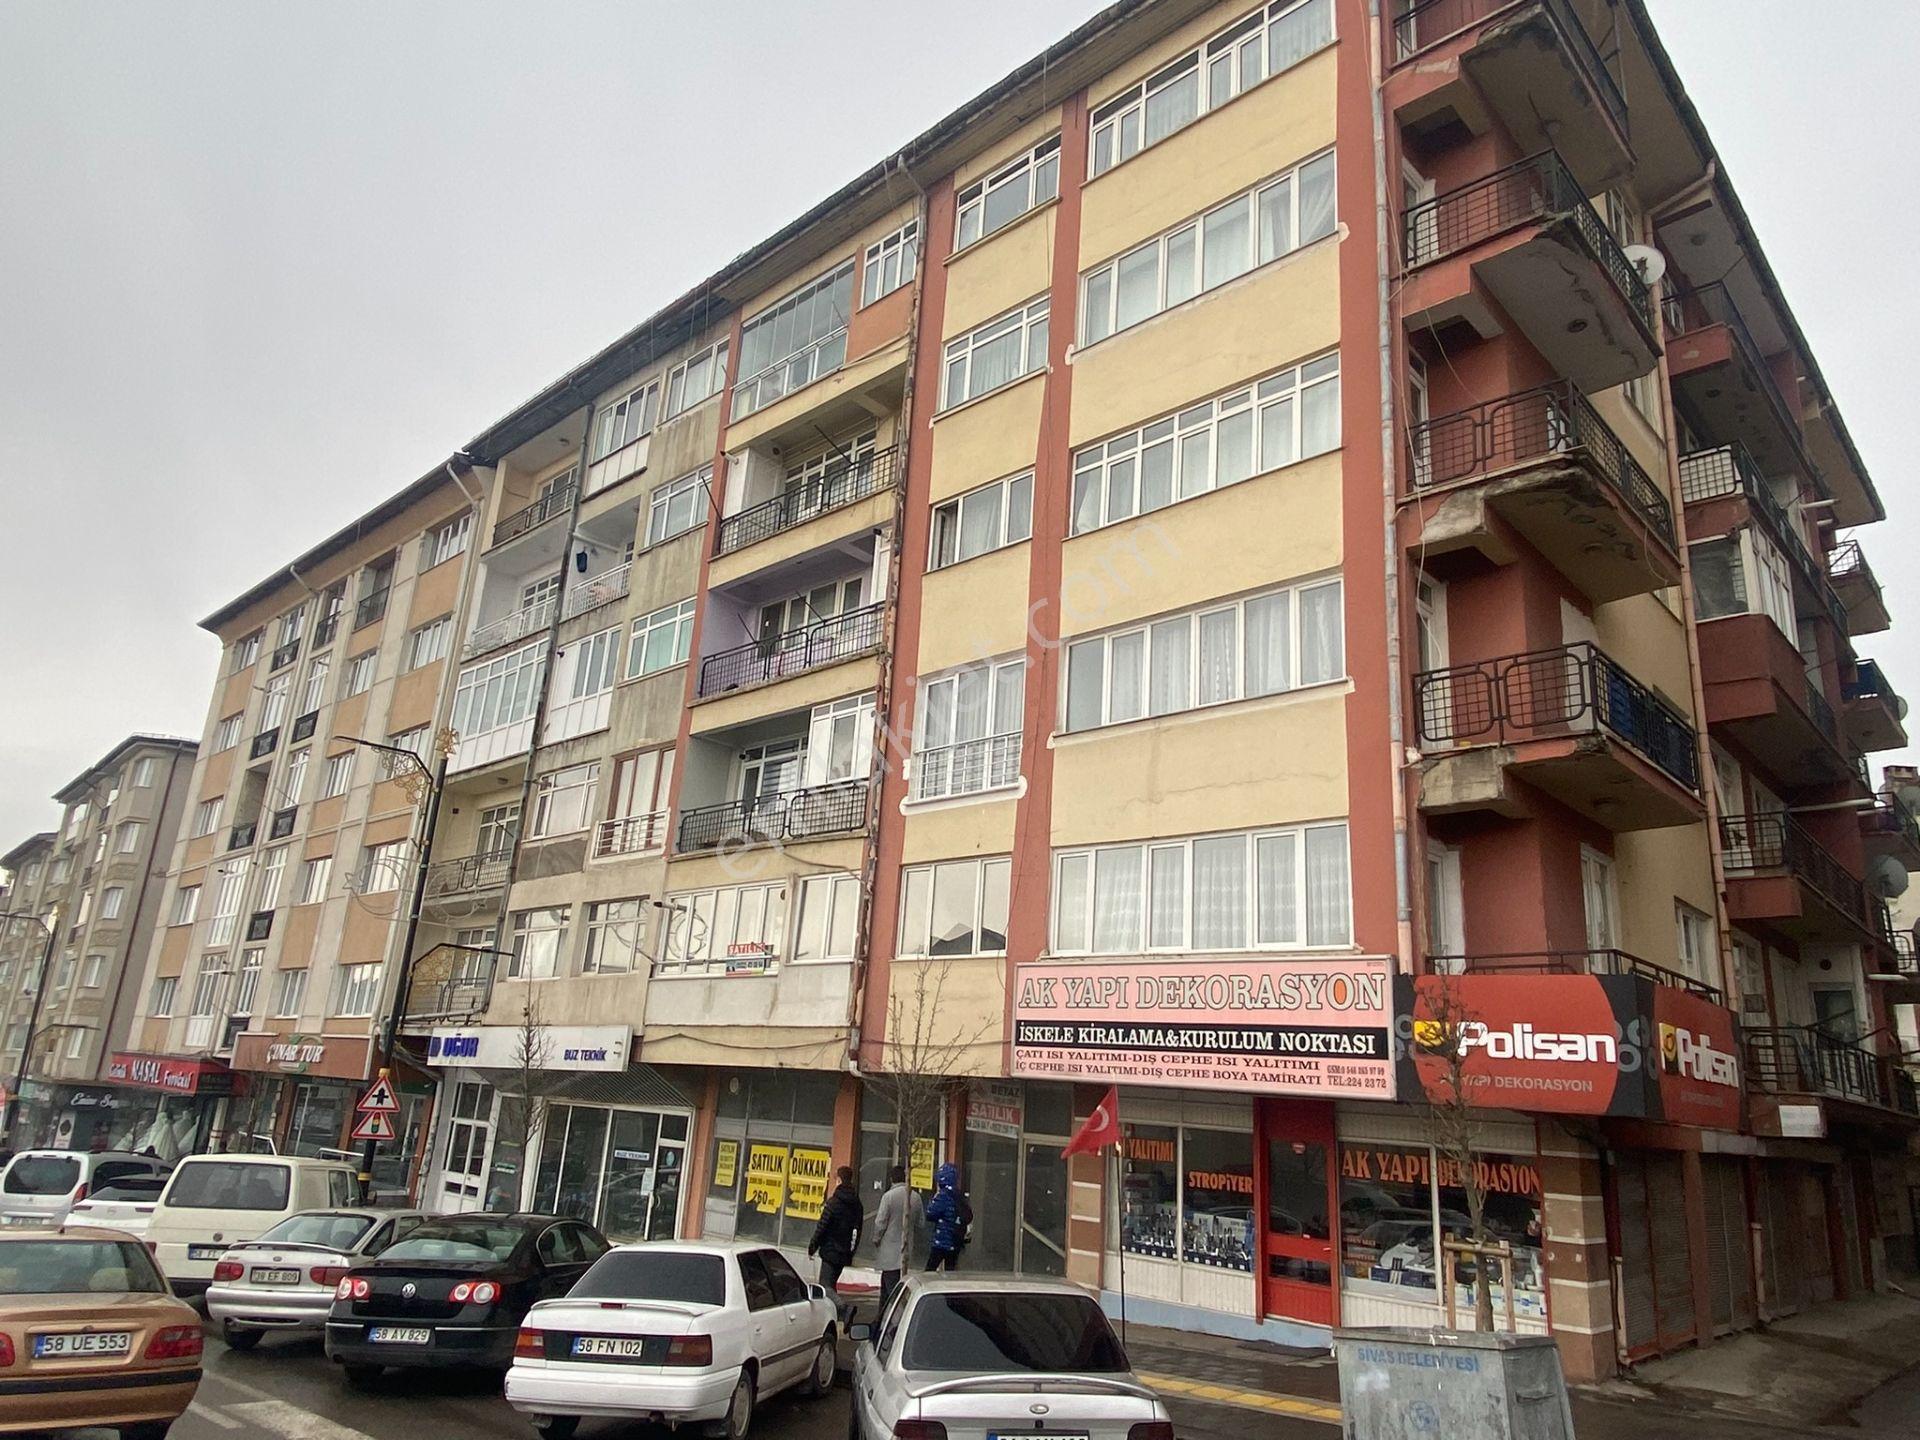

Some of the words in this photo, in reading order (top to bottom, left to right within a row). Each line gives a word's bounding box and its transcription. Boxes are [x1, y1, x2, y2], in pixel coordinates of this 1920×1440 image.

[1018, 977, 1057, 1008] AK
[1062, 976, 1129, 1009] YAPI
[1135, 972, 1386, 1011] DEKORASYON
[1018, 1021, 1074, 1043] İSKELE
[1077, 1022, 1274, 1051] KİRALAMA&KURULUM
[1279, 1032, 1376, 1055] NOKTASI
[1456, 1021, 1617, 1063] Polisan
[1016, 1049, 1043, 1060] ÇATI
[1046, 1050, 1065, 1059] ISI
[1161, 1054, 1213, 1065] CEPHE
[1216, 1056, 1237, 1066] ISI
[1243, 1057, 1321, 1071] YALITIMI
[1676, 1027, 1739, 1089] Polisan
[1029, 1062, 1065, 1072] CEPHE
[1067, 1064, 1083, 1073] ISI
[1166, 1067, 1211, 1079] CEPHE
[1212, 1070, 1248, 1081] BOYA
[1251, 1071, 1322, 1086] TAMİRATI
[1493, 1076, 1593, 1093] DEKORASYON
[1128, 1138, 1174, 1162] YALITIMI
[751, 1153, 785, 1174] SATILIK
[791, 1154, 827, 1178] DÜKKAN
[1341, 1150, 1372, 1179] AK
[1376, 1152, 1430, 1185] YAPI
[44, 1336, 65, 1352] 58
[72, 1335, 96, 1350] UE
[98, 1334, 128, 1349] 553
[375, 1326, 388, 1340] 58
[391, 1328, 408, 1341] AV
[408, 1328, 428, 1342] 829
[578, 1338, 593, 1352] 58
[597, 1340, 616, 1353] FN
[620, 1341, 641, 1355] 102
